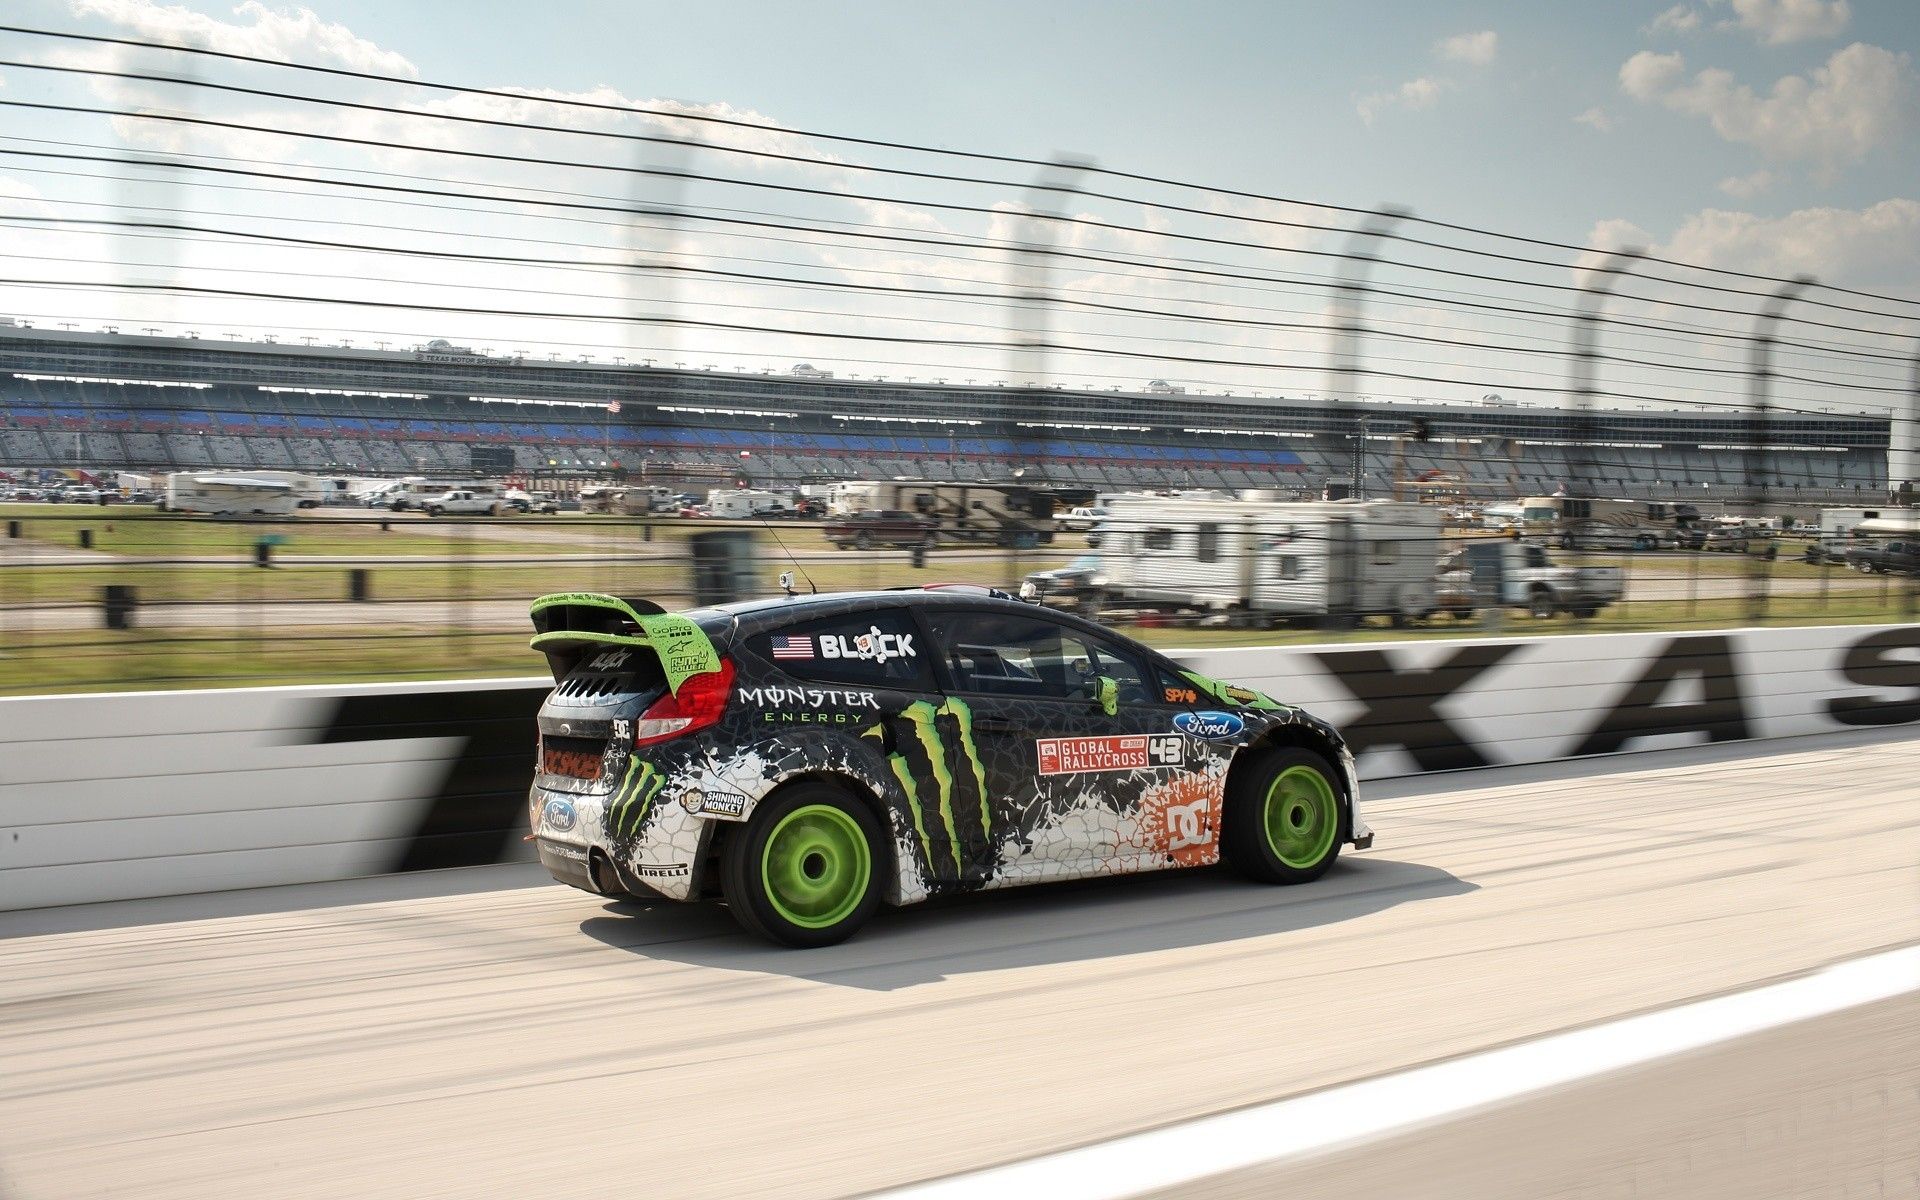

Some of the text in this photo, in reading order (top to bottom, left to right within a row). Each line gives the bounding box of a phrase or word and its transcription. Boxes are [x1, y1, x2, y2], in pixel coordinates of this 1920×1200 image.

[426, 354, 511, 367] TEXAS MOTOR SPEEDWAY
[652, 626, 692, 634] GoPro
[671, 663, 706, 673] POWER
[738, 685, 881, 710] MONSTER
[1165, 688, 1186, 702] SPY
[764, 712, 862, 723] ENERGY
[1187, 715, 1230, 735] Ford
[1062, 740, 1114, 755] GLOBAL
[1149, 737, 1182, 763] 43
[1063, 752, 1145, 769] RALLYCROSS
[706, 791, 745, 804] SHINING
[704, 800, 742, 814] MONKEY
[550, 802, 570, 827] Ford
[1166, 798, 1213, 851] DC
[636, 863, 689, 877] PIRELLI
